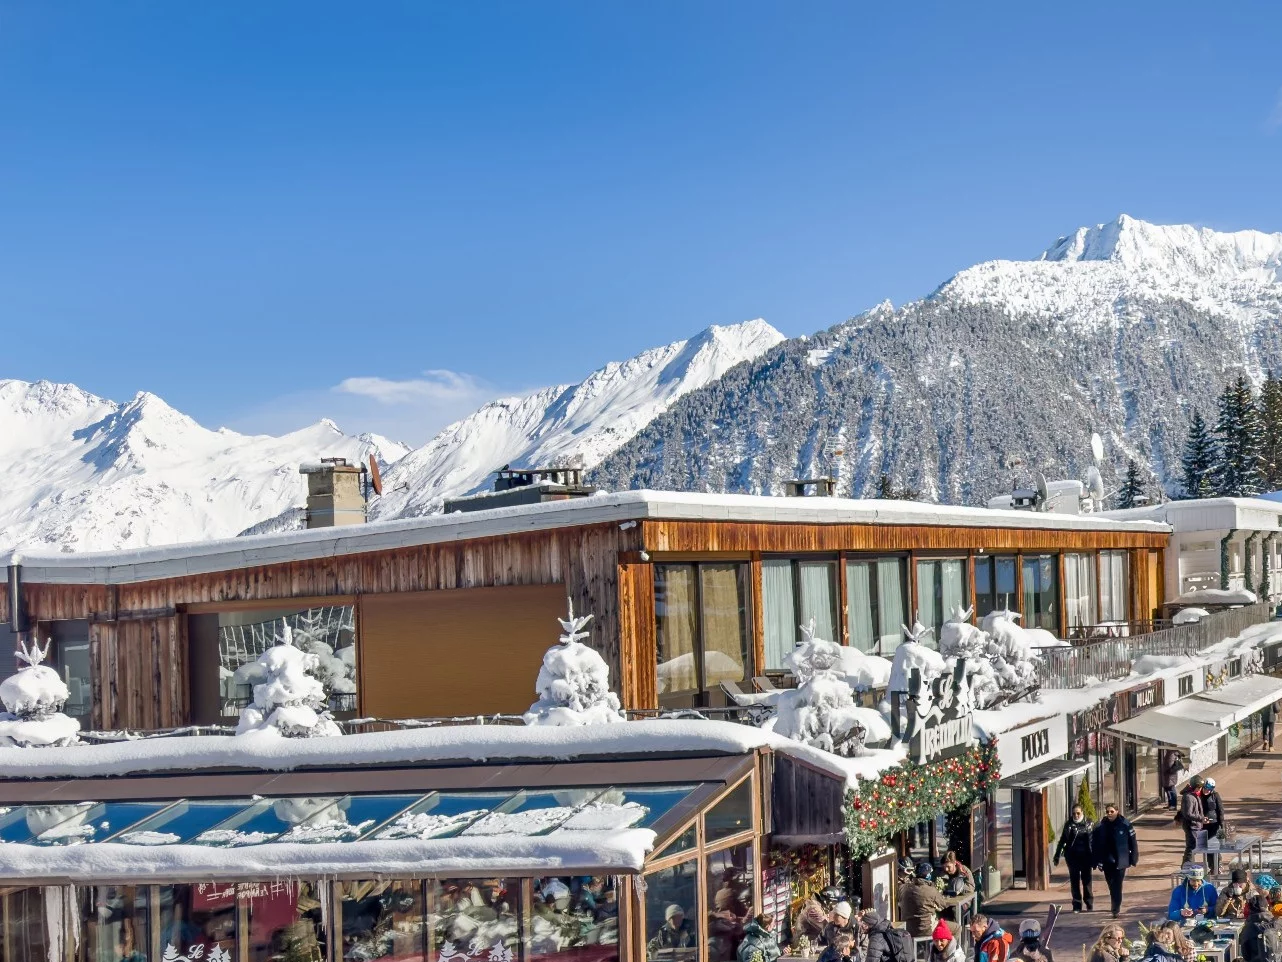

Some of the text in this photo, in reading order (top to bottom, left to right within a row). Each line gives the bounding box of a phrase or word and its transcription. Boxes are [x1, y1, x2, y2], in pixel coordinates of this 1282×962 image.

[1020, 727, 1050, 763] PUCCI
[187, 943, 205, 959] Le
[467, 939, 484, 956] Le
